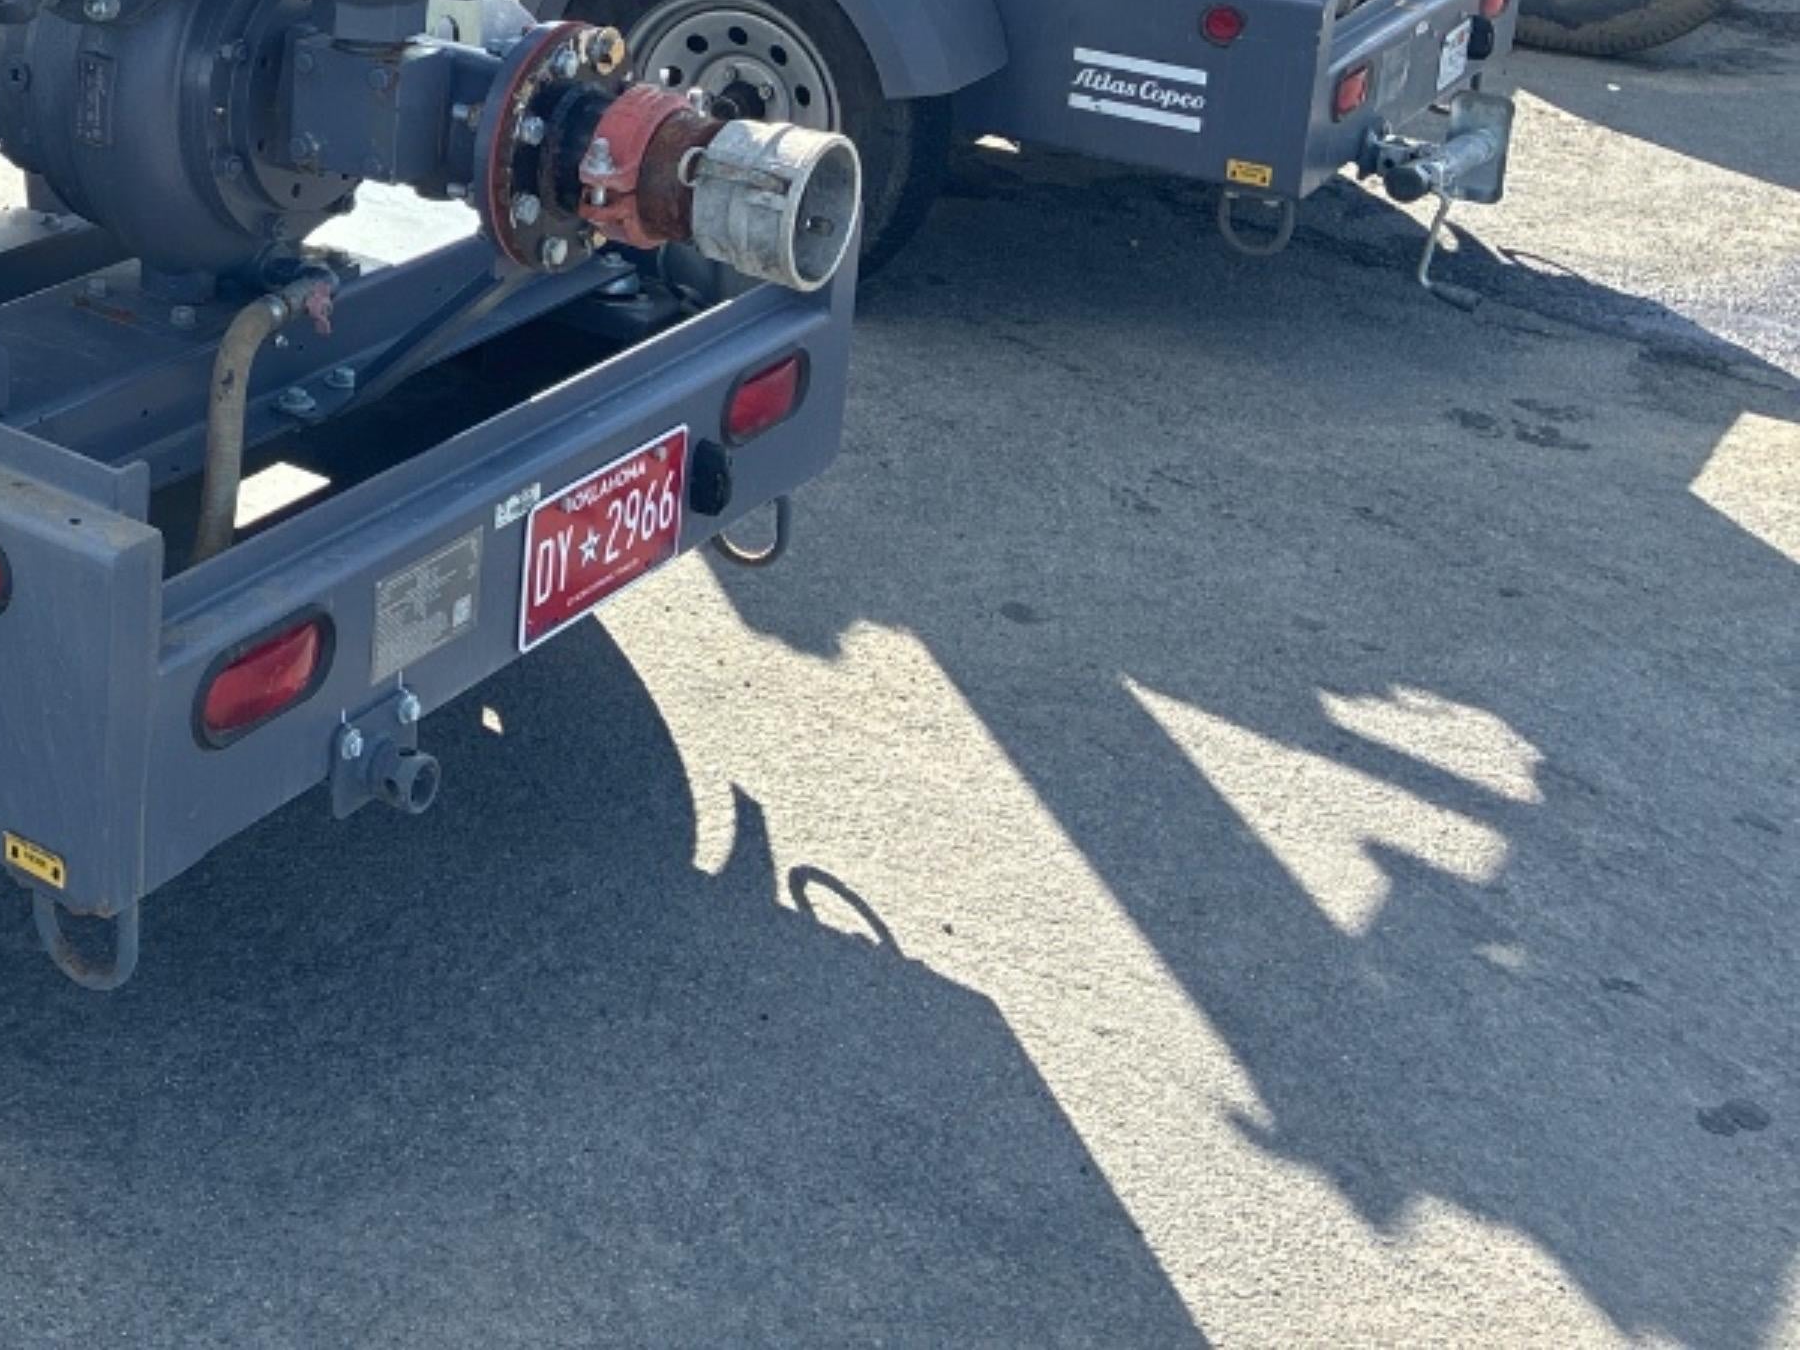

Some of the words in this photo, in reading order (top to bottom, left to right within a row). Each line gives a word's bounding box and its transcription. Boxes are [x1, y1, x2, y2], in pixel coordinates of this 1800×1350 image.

[1071, 67, 1138, 97] Atlas
[1139, 79, 1206, 109] Copco
[533, 524, 575, 608] DY
[604, 470, 676, 565] 2966
